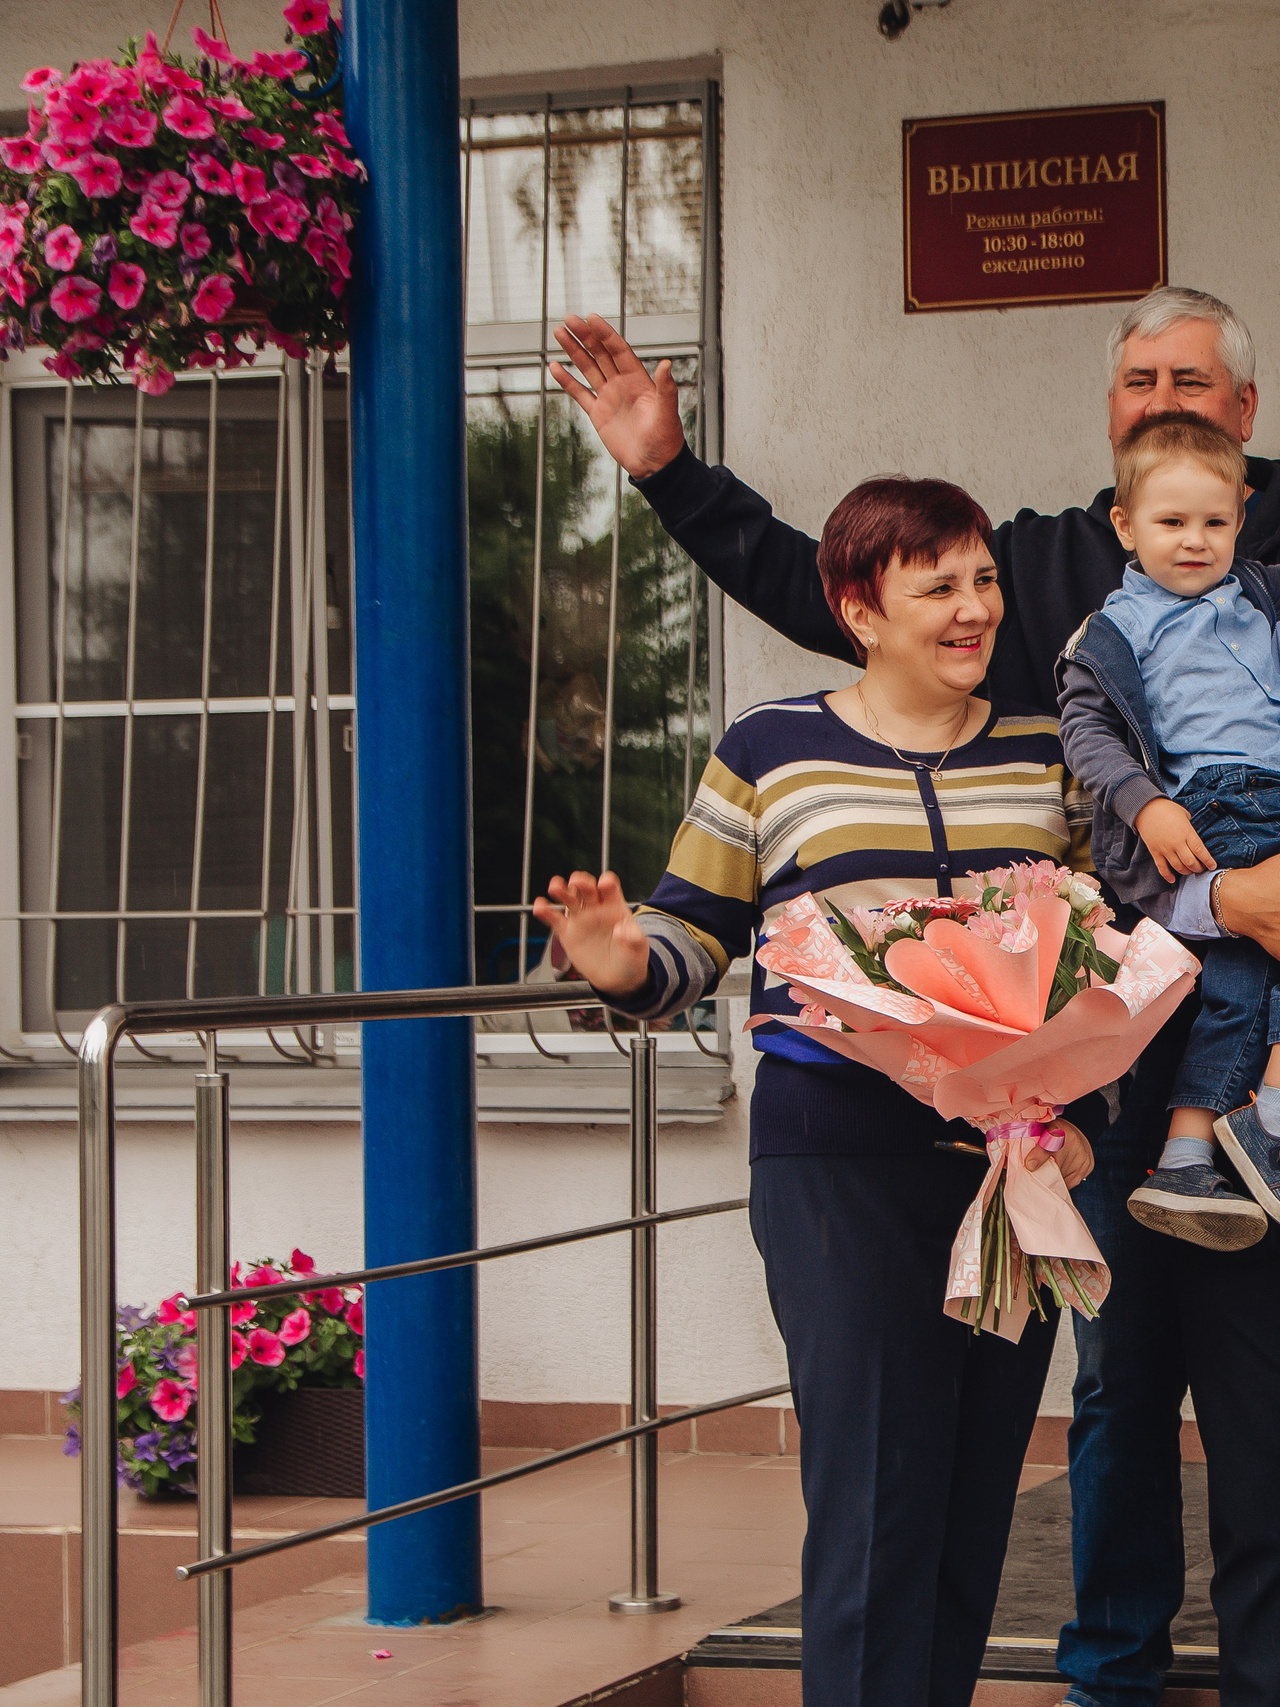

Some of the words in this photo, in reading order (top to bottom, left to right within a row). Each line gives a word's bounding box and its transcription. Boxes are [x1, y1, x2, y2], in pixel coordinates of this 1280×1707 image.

[928, 152, 1139, 195] ВЫПИСНАЯ
[966, 213, 1026, 230] Режим
[1031, 206, 1104, 229] работы:
[983, 234, 1028, 253] 10:30
[1040, 230, 1084, 249] 18:00
[982, 254, 1085, 274] ежедневно
